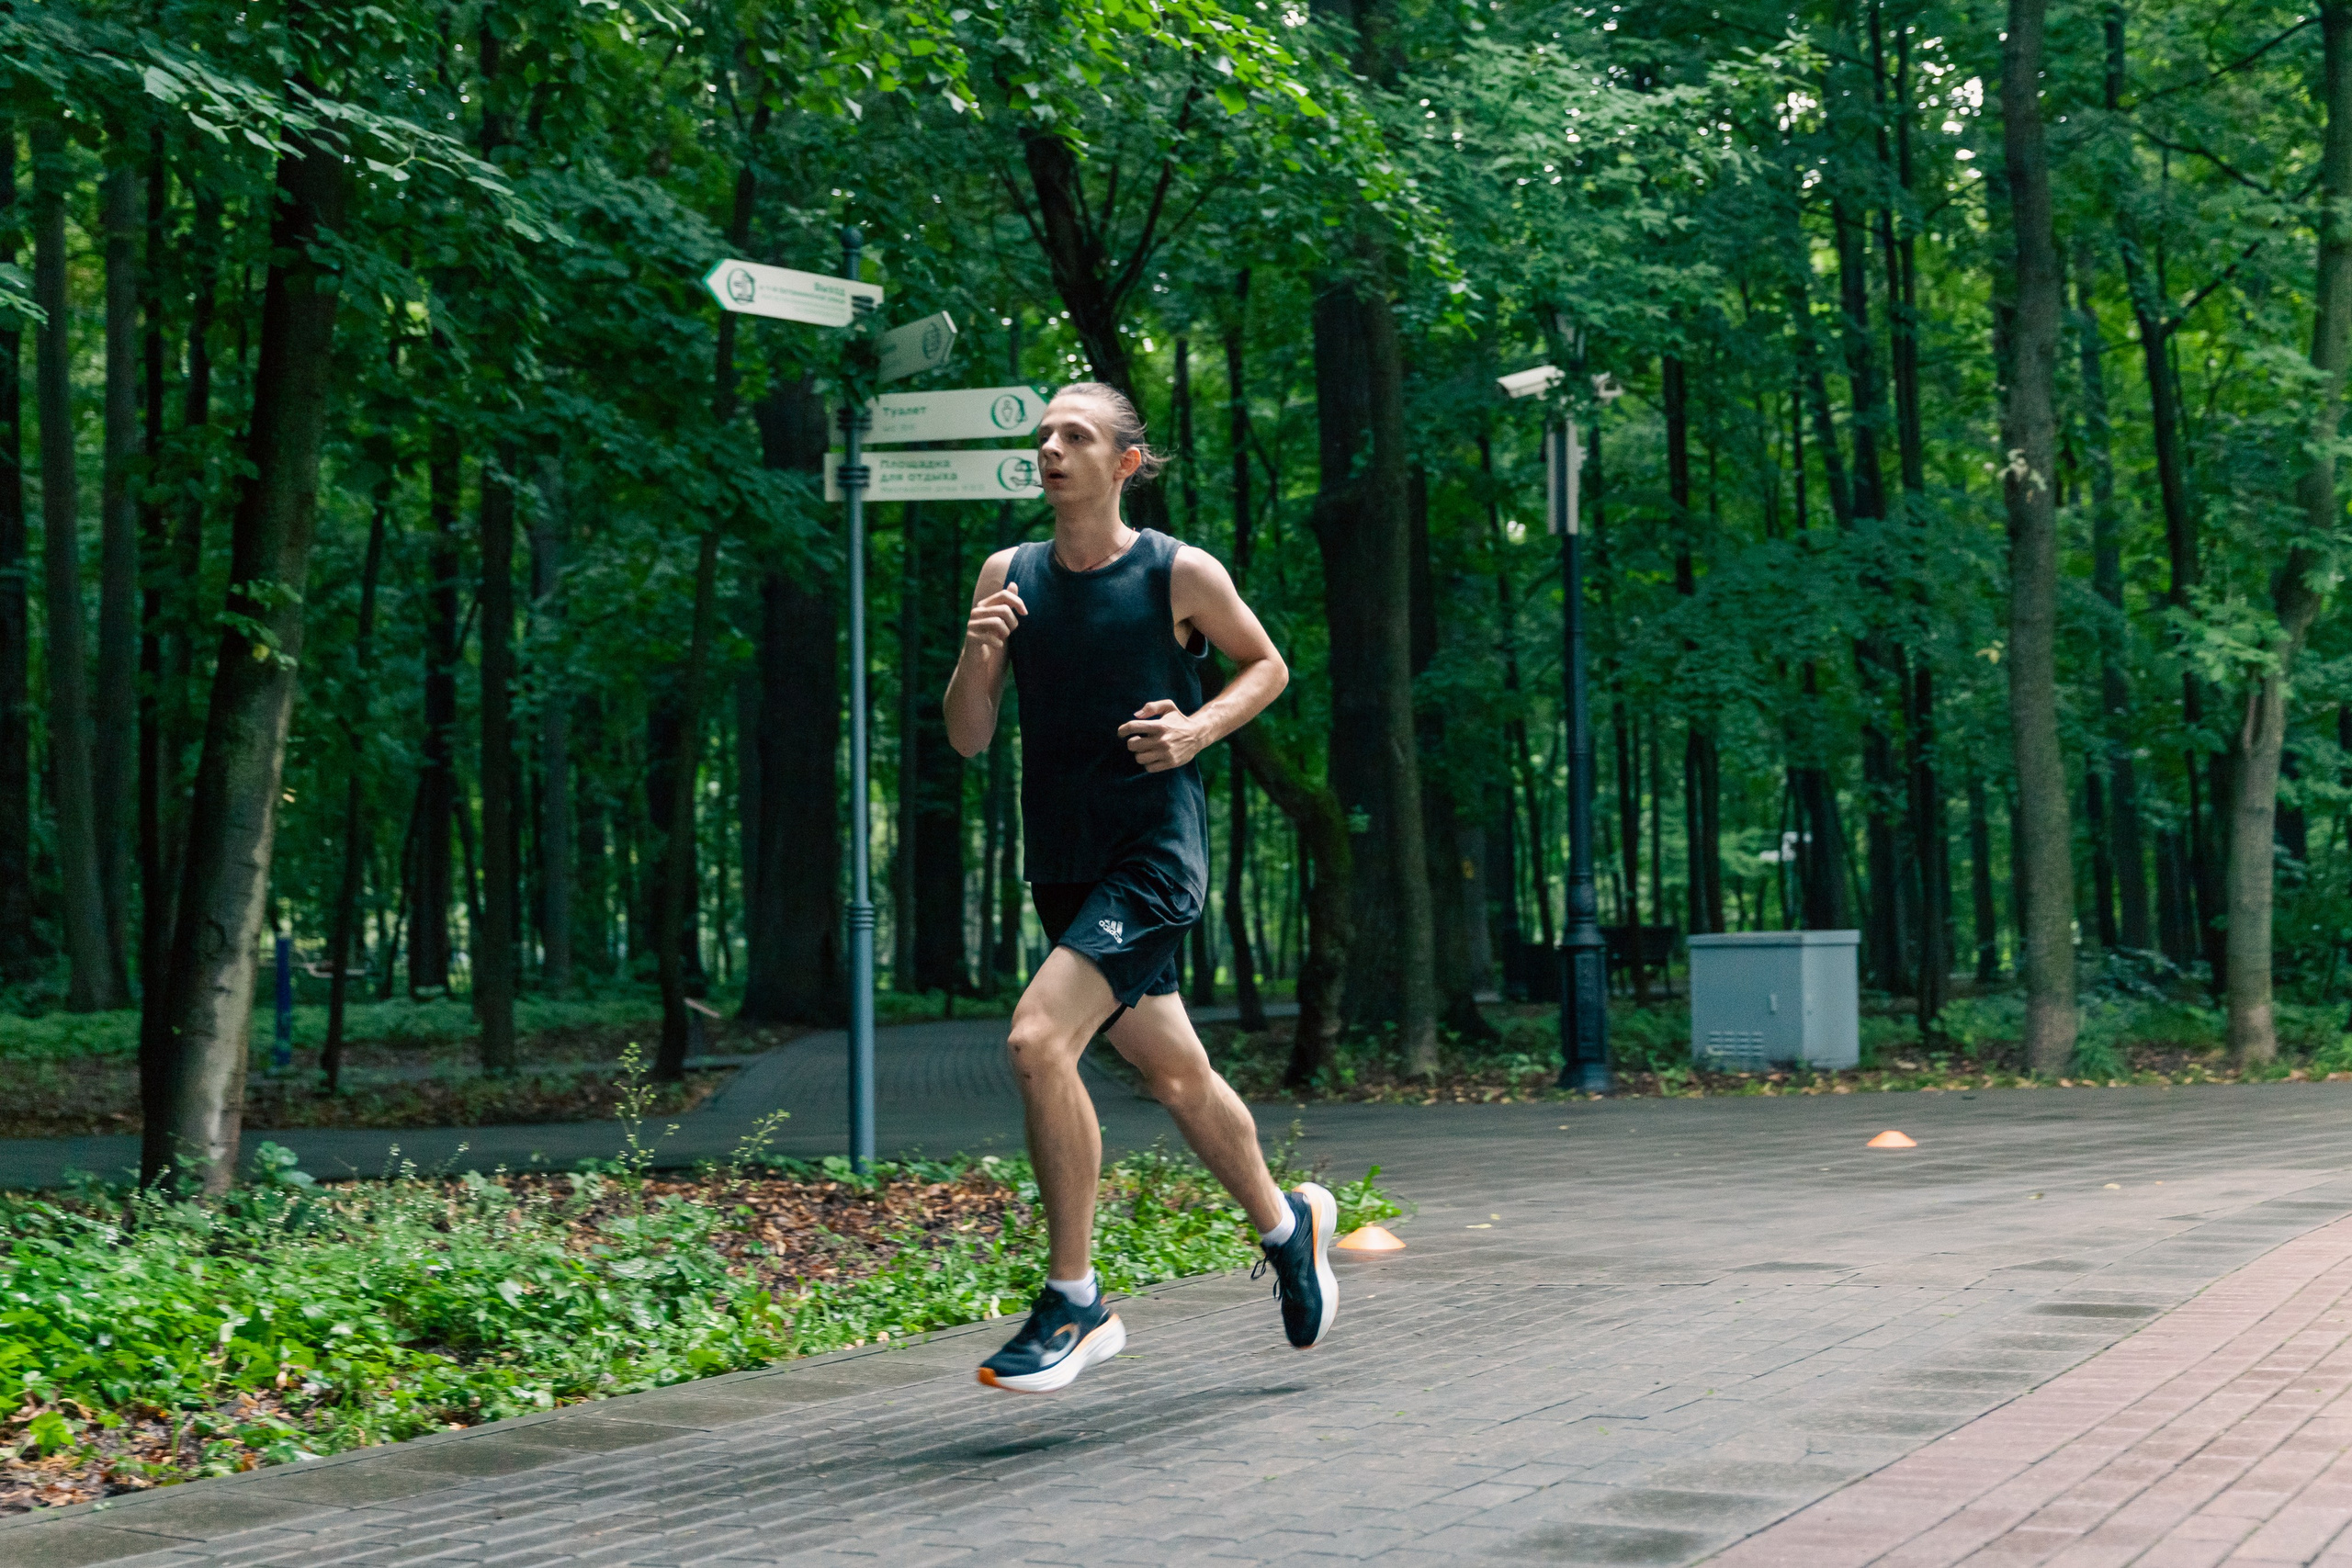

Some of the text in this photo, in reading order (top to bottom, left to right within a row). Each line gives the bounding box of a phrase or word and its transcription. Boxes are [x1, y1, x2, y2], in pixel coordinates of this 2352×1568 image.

[882, 406, 928, 418] Туалет
[879, 458, 952, 469] Площадка
[879, 471, 958, 483] для отдыха
[1098, 919, 1124, 944] adidas
